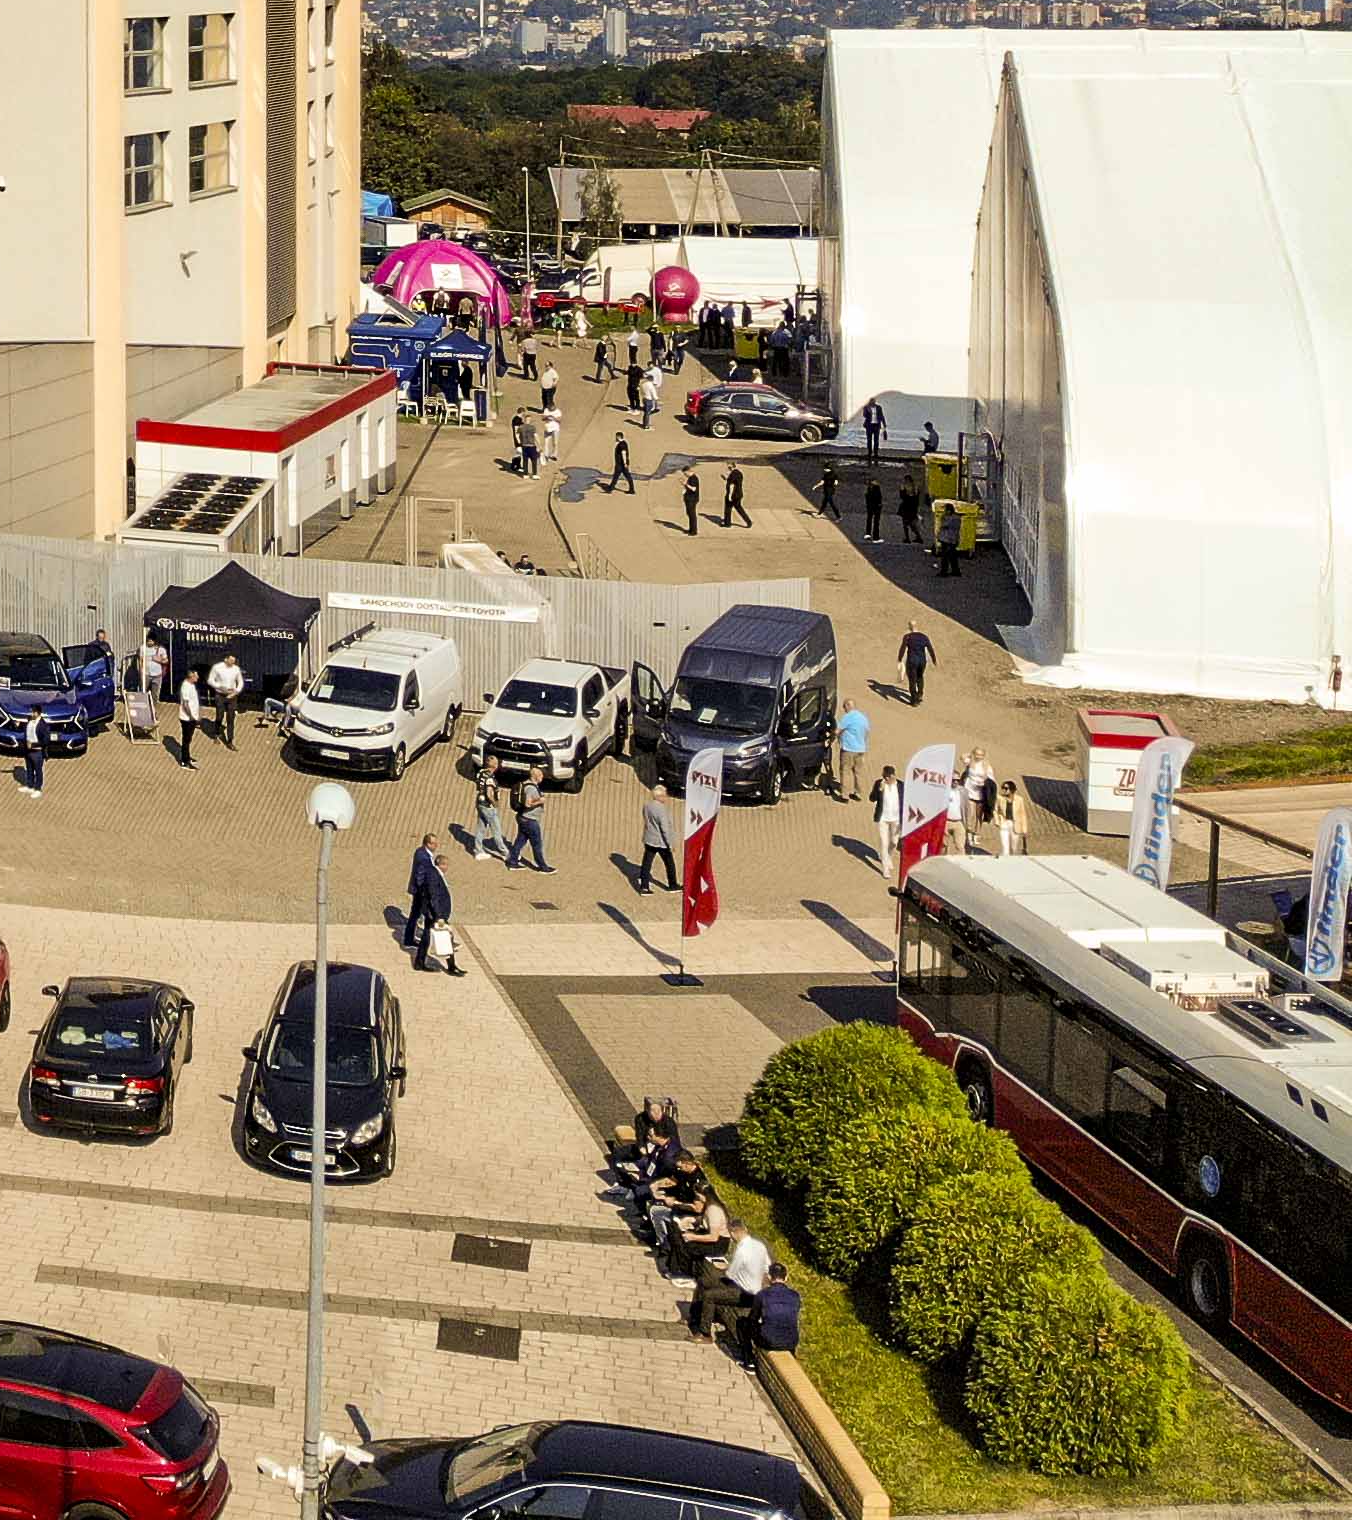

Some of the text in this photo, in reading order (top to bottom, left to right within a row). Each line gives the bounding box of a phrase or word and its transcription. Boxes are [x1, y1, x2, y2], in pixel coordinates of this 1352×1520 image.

[471, 607, 506, 617] TOYOTA
[180, 621, 208, 632] Toyota
[210, 623, 262, 637] Professional
